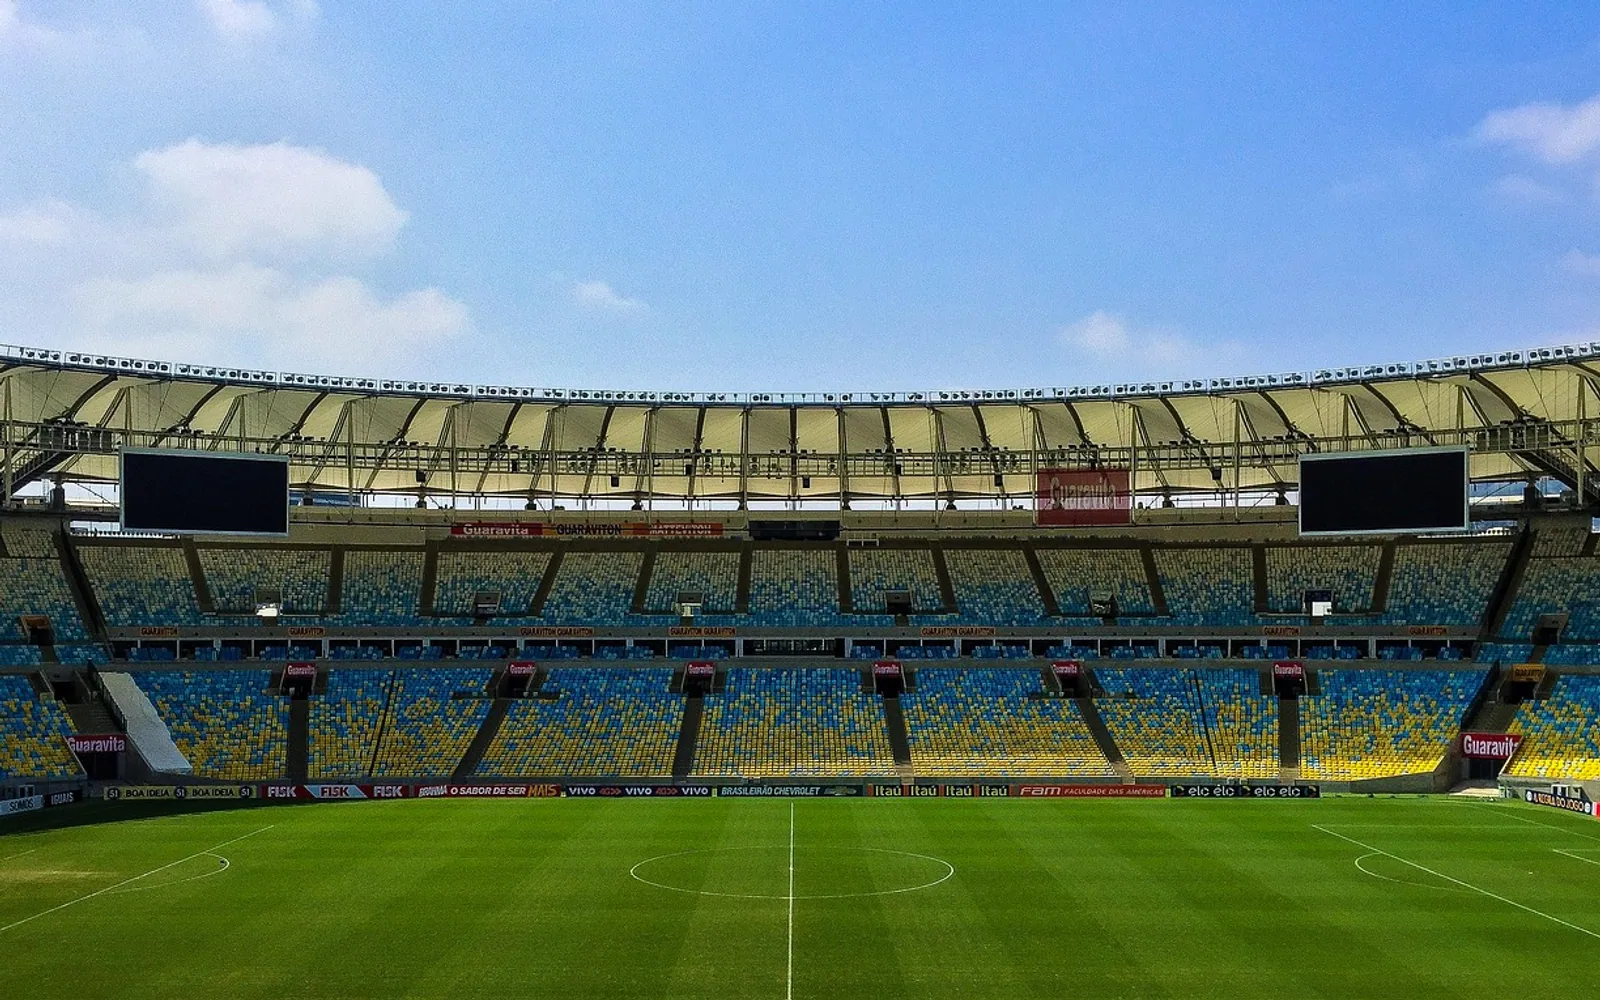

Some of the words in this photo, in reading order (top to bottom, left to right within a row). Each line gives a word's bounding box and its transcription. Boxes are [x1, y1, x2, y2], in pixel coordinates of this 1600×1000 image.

[1050, 477, 1117, 510] Guaravita
[463, 524, 529, 535] Guaravita
[557, 524, 622, 535] GUARAVITON
[67, 736, 125, 752] Guaravita
[126, 789, 145, 797] BOA
[146, 789, 170, 797] IDEIA
[192, 788, 210, 797] BOA
[211, 788, 234, 797] IDEIA
[268, 785, 297, 797] FISK
[320, 786, 349, 797] FISK
[373, 785, 403, 797] FISK
[450, 786, 459, 795] O
[460, 786, 492, 795] SABOR
[493, 786, 506, 795] DE
[507, 786, 527, 795] SER
[527, 784, 558, 797] MAIS
[721, 785, 773, 796] BRASILEIRÃO
[774, 786, 821, 796] CHEVROLET
[875, 785, 902, 796] Itaú
[910, 785, 937, 796] Itaú
[946, 785, 972, 796] Itaú
[981, 785, 1007, 796] Itaú
[1063, 787, 1106, 796] FACULDADE
[1108, 787, 1124, 796] DAS
[50, 792, 74, 805] IGUAIS
[9, 798, 34, 812] SOMOS
[1566, 798, 1584, 812] JOGO
